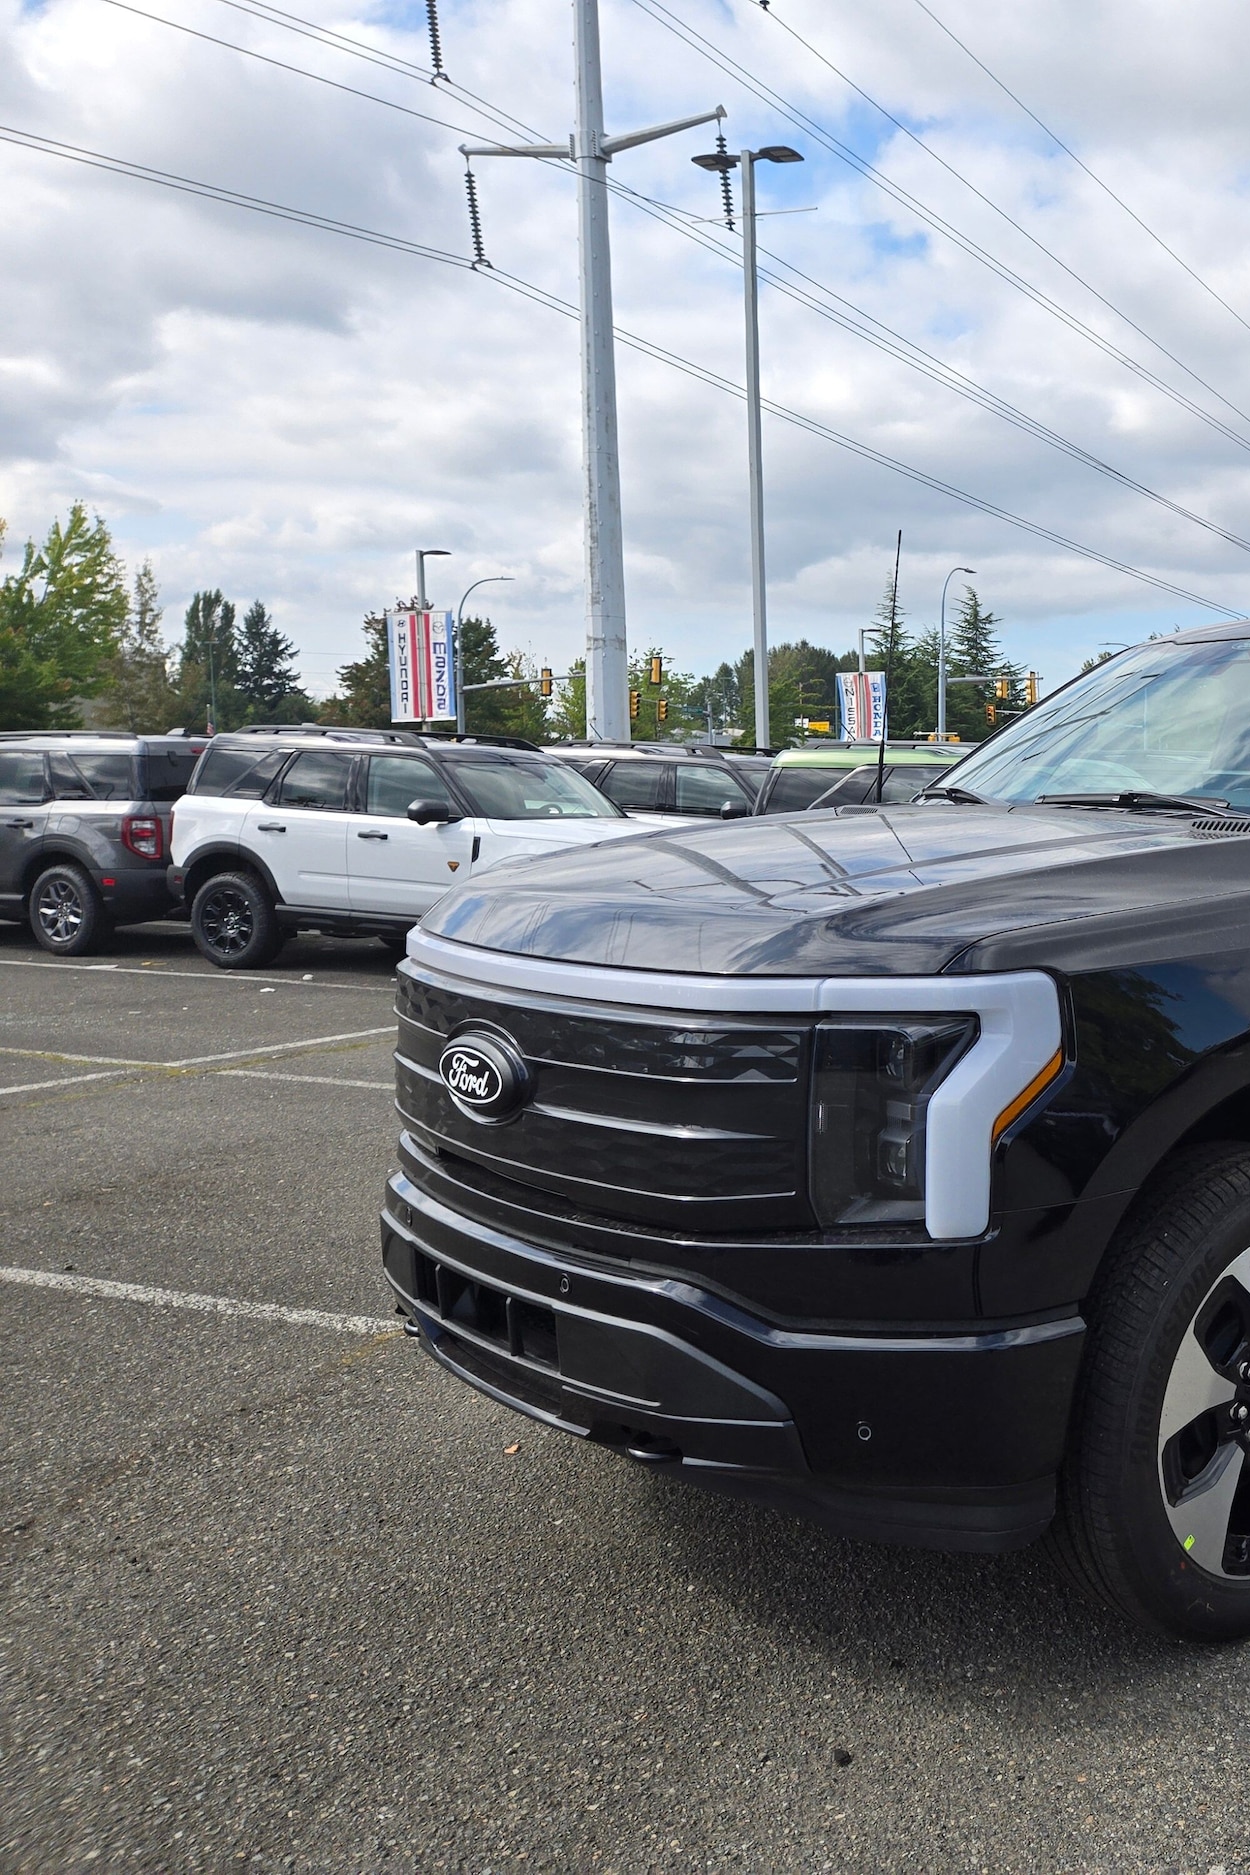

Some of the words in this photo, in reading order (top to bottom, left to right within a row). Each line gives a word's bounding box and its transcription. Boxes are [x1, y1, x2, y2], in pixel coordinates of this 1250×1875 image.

[397, 633, 409, 714] HYUNDAI
[872, 696, 882, 737] HONDA
[448, 1053, 490, 1097] Ford
